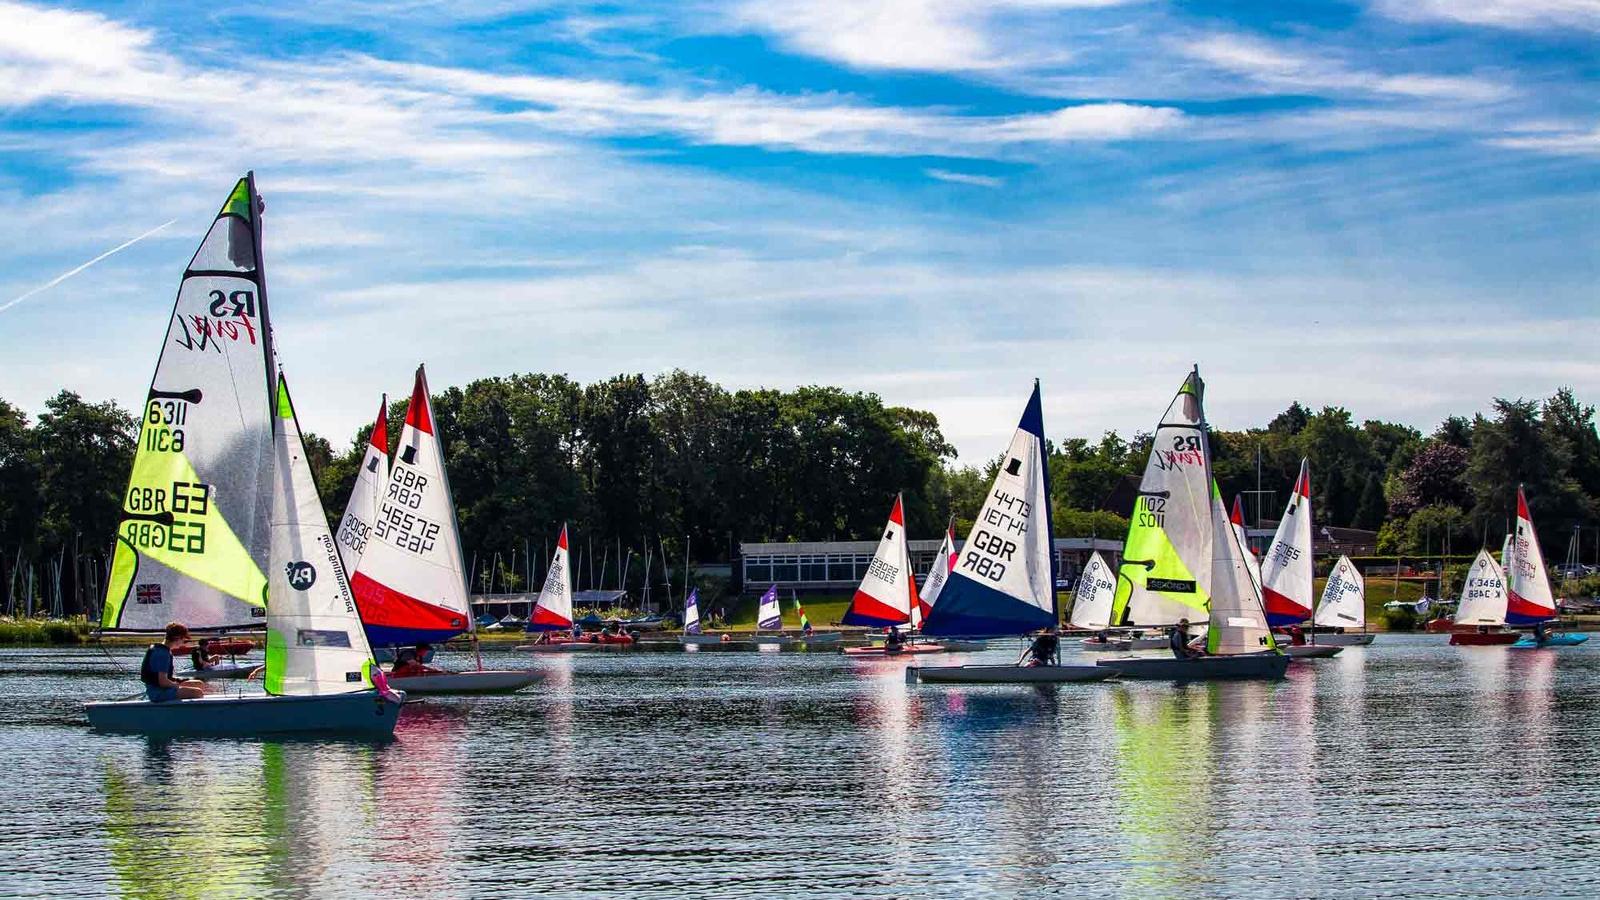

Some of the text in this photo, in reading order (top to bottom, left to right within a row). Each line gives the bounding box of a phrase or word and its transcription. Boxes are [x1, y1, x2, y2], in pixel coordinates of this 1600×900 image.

[149, 401, 187, 426] 6311
[393, 466, 428, 493] GBR
[129, 481, 209, 515] GBR 63
[382, 503, 440, 541] 46572
[974, 530, 1017, 562] GBR
[1095, 578, 1113, 592] GBR
[1343, 582, 1360, 594] GBR
